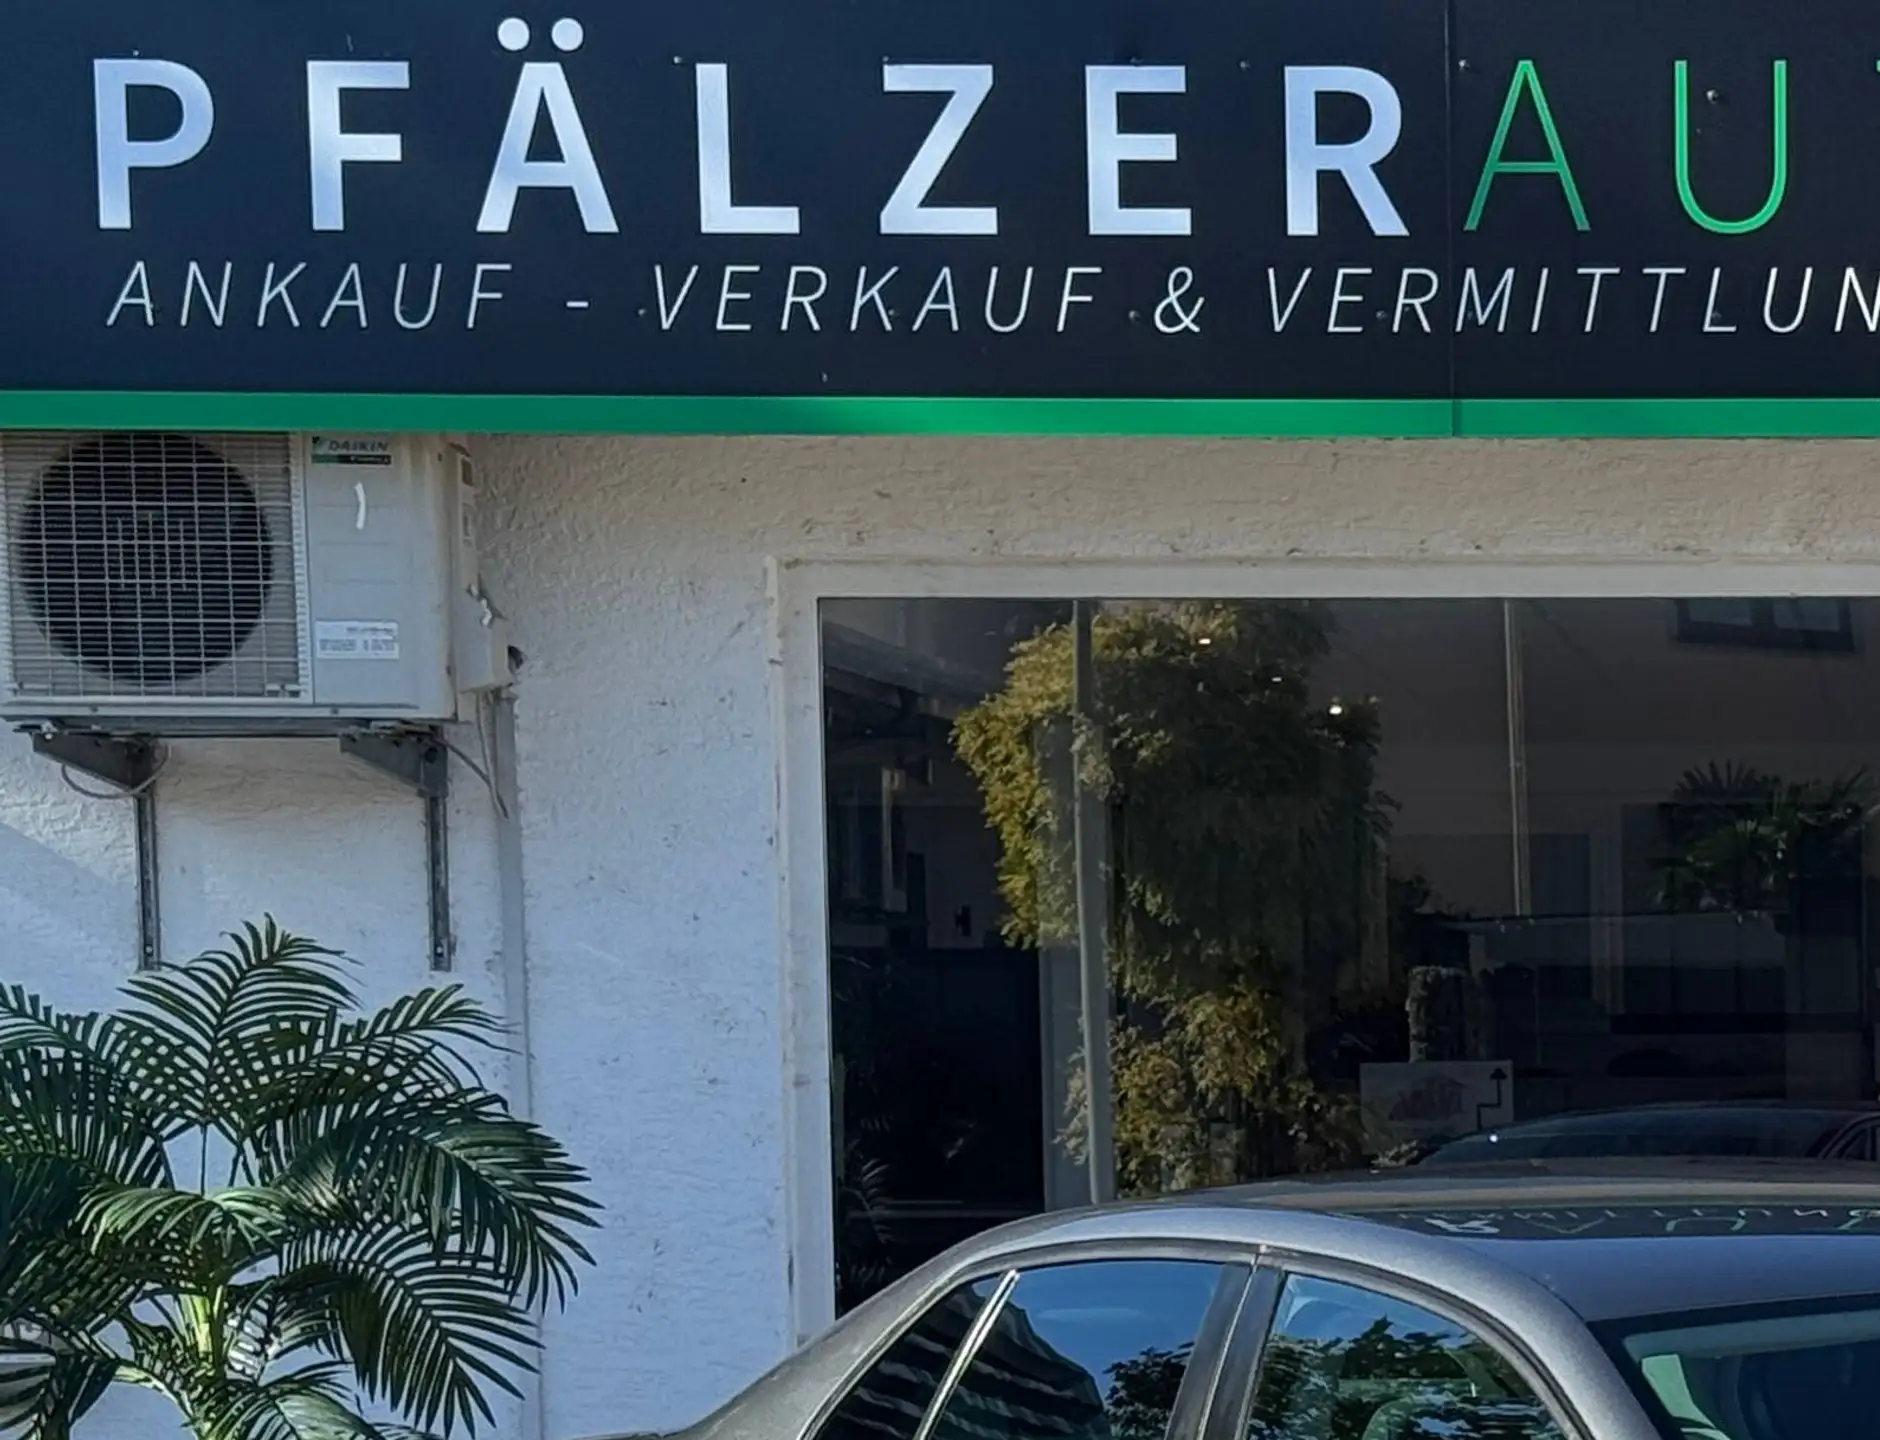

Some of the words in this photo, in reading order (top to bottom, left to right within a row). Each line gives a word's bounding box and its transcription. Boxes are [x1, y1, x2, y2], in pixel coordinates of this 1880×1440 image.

[107, 260, 513, 329] ANKAUF
[654, 264, 1103, 333] VERKAUF
[1153, 265, 1207, 334] &
[328, 440, 389, 452] DAIKIN
